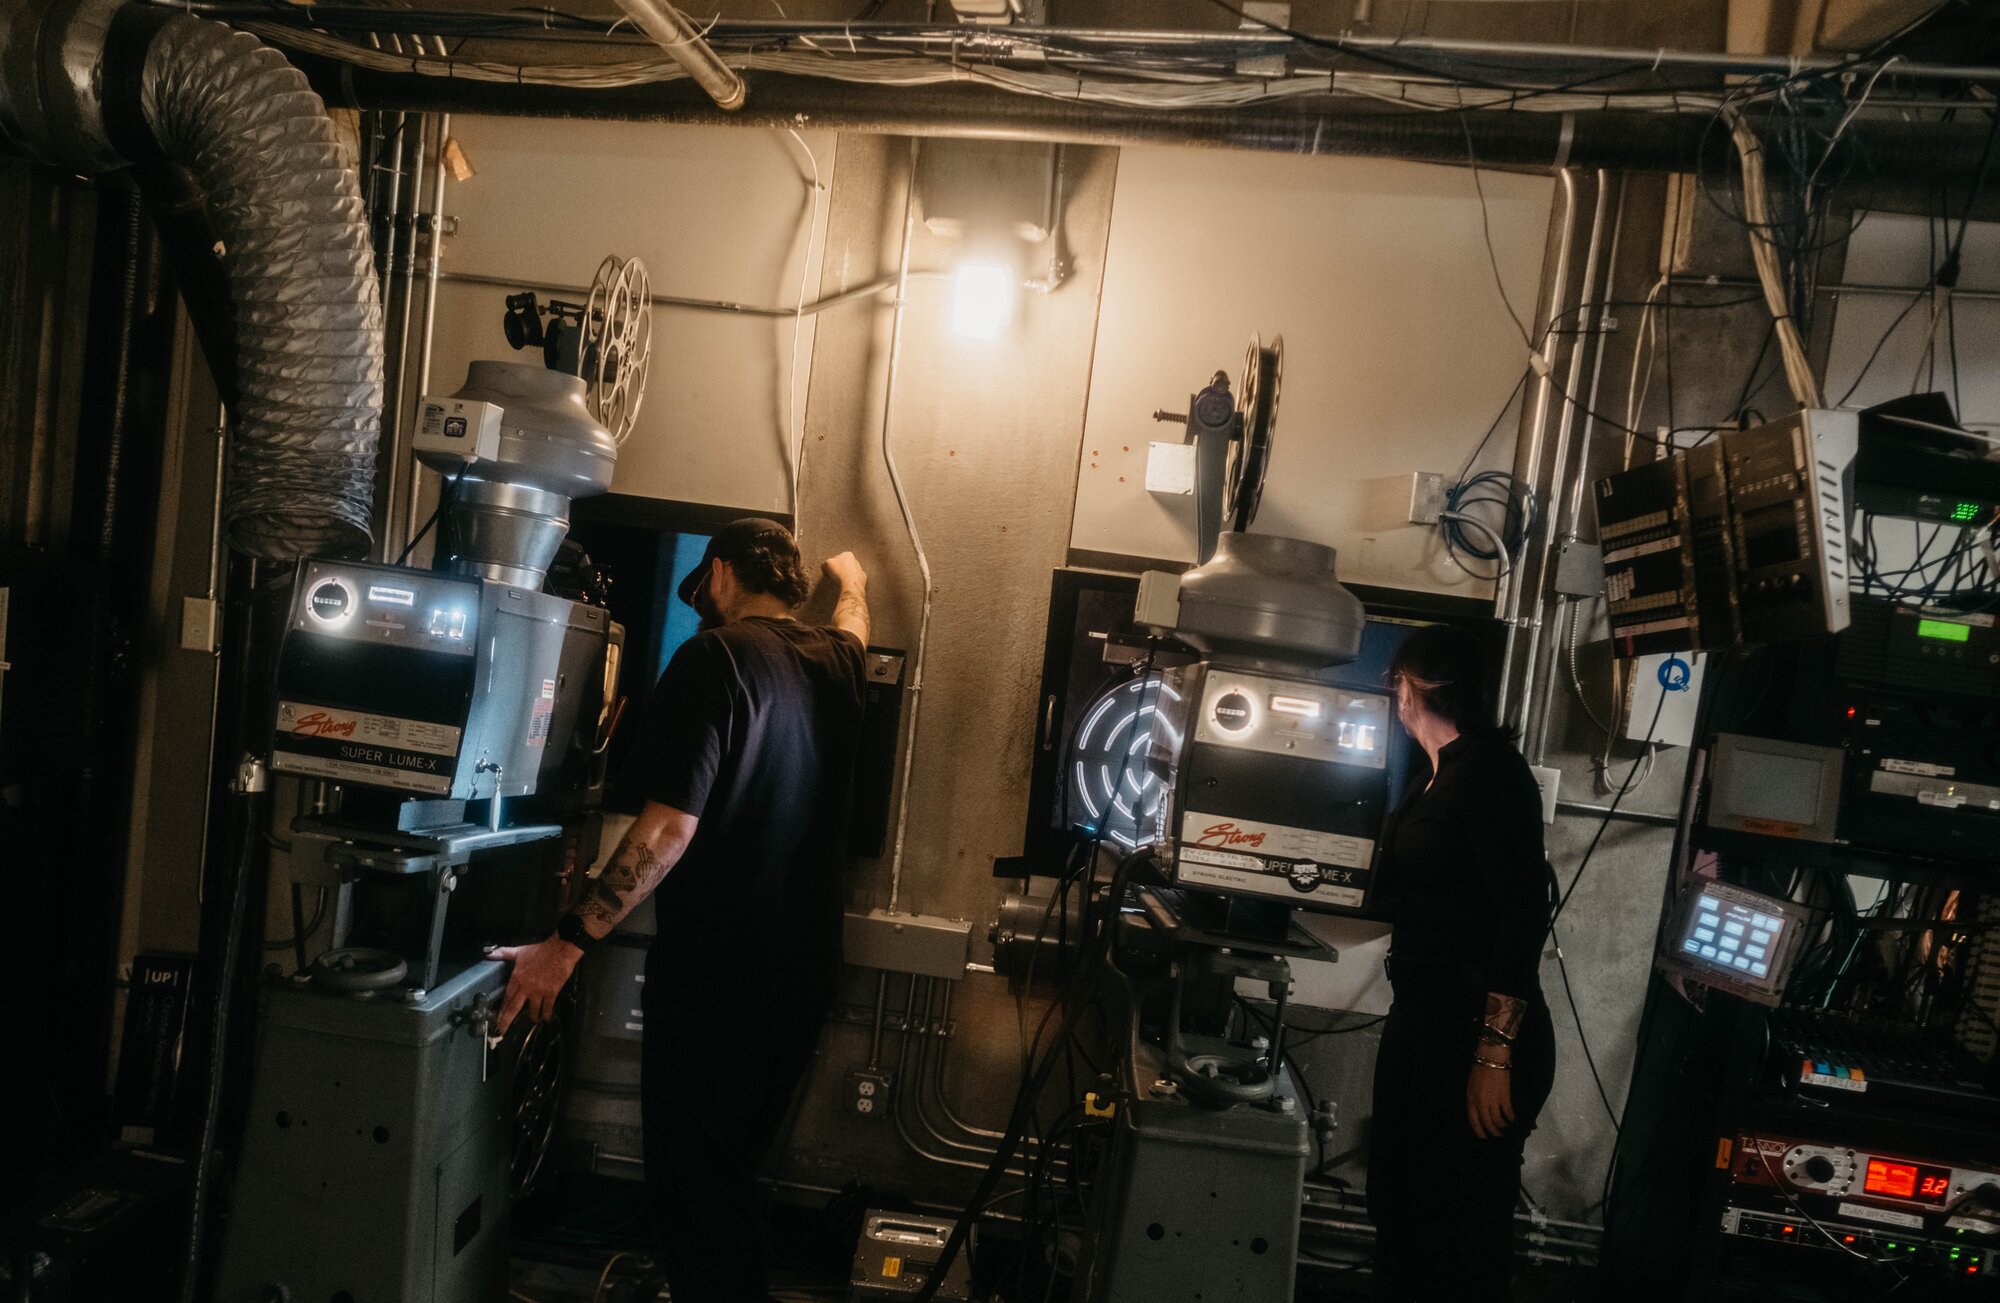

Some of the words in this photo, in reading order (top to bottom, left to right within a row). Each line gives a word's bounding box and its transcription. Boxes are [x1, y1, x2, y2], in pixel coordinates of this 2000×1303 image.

[291, 712, 358, 740] Strong
[340, 745, 383, 762] SUPER
[389, 753, 437, 770] LUME-X
[1196, 823, 1266, 850] Strong
[1218, 874, 1247, 884] ELECTRIC
[151, 972, 172, 983] UP
[1920, 1177, 1948, 1194] 3.2
